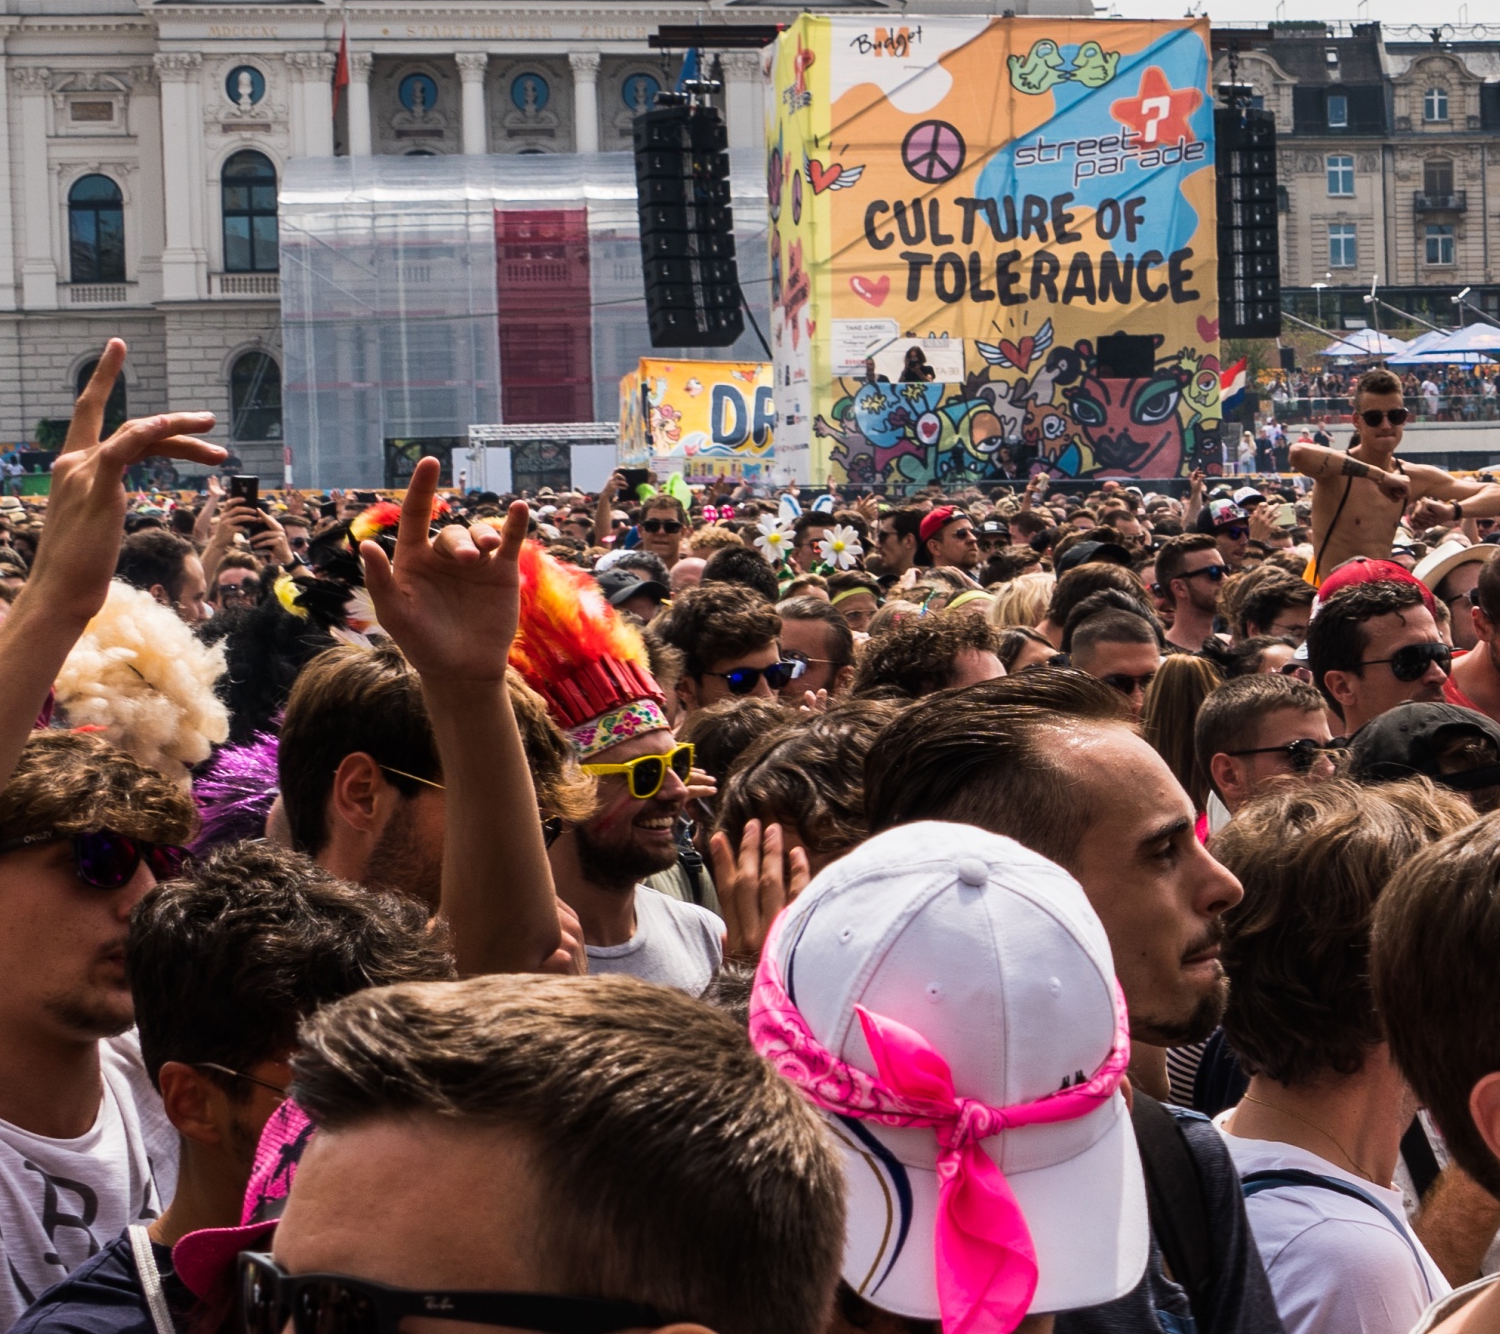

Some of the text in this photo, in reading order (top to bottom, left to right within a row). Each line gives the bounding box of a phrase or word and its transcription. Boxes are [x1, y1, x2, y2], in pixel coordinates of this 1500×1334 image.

[850, 25, 923, 57] Budget
[1014, 125, 1143, 168] street
[1073, 135, 1207, 188] parade
[863, 192, 1147, 251] CULTURE OF
[899, 247, 1201, 307] TOLERANCE
